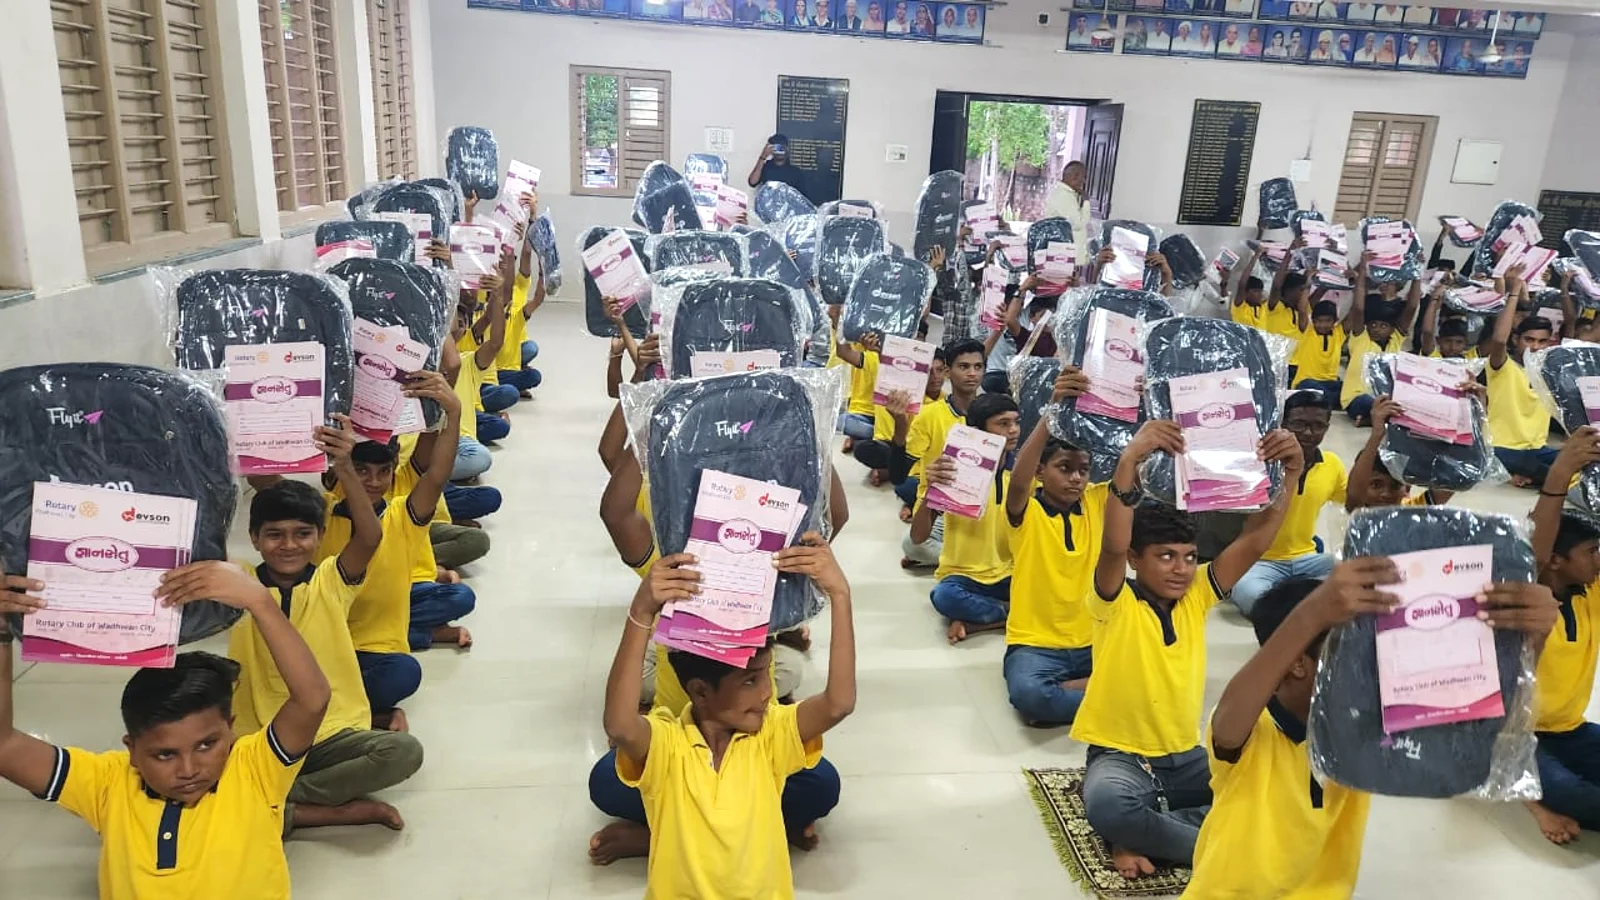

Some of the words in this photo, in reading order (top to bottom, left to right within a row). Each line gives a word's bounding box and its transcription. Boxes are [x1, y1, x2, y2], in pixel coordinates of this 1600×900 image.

[45, 499, 77, 512] Rotary
[121, 506, 170, 523] devson
[1442, 559, 1484, 575] devson
[36, 618, 64, 629] Rotary
[66, 620, 85, 629] Club
[86, 620, 95, 629] of
[98, 622, 138, 632] Wadhwan
[140, 624, 156, 634] City
